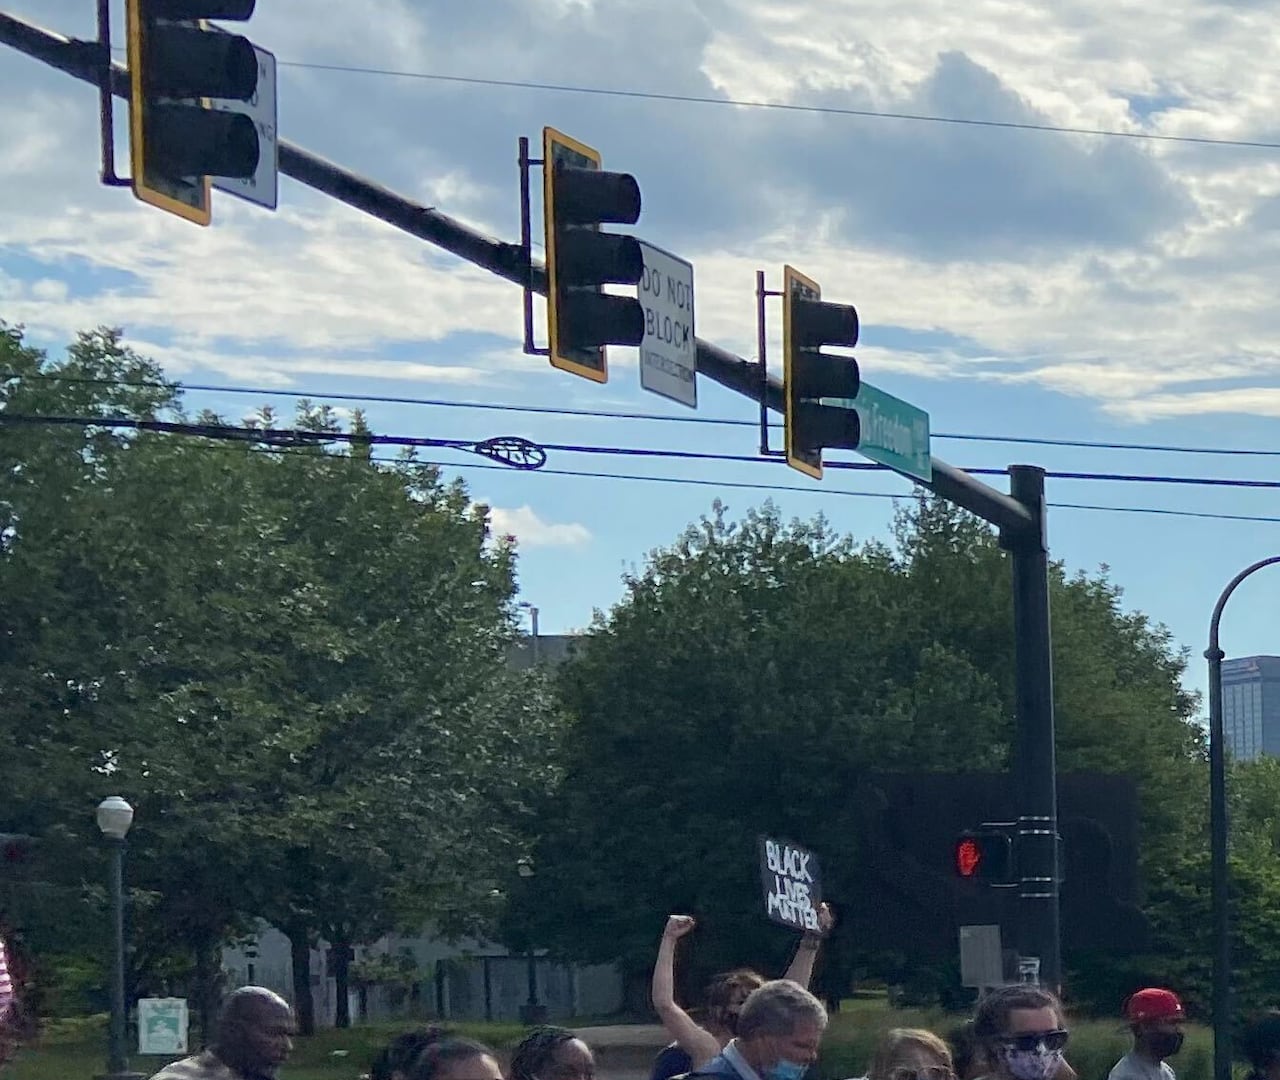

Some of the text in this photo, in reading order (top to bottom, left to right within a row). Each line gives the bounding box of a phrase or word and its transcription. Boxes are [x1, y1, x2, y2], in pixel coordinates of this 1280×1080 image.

[642, 264, 691, 312] DO NOT
[645, 307, 690, 351] BLOCK
[766, 840, 814, 883] BLACK
[767, 891, 822, 933] MATTER
[775, 874, 811, 909] LIVES
